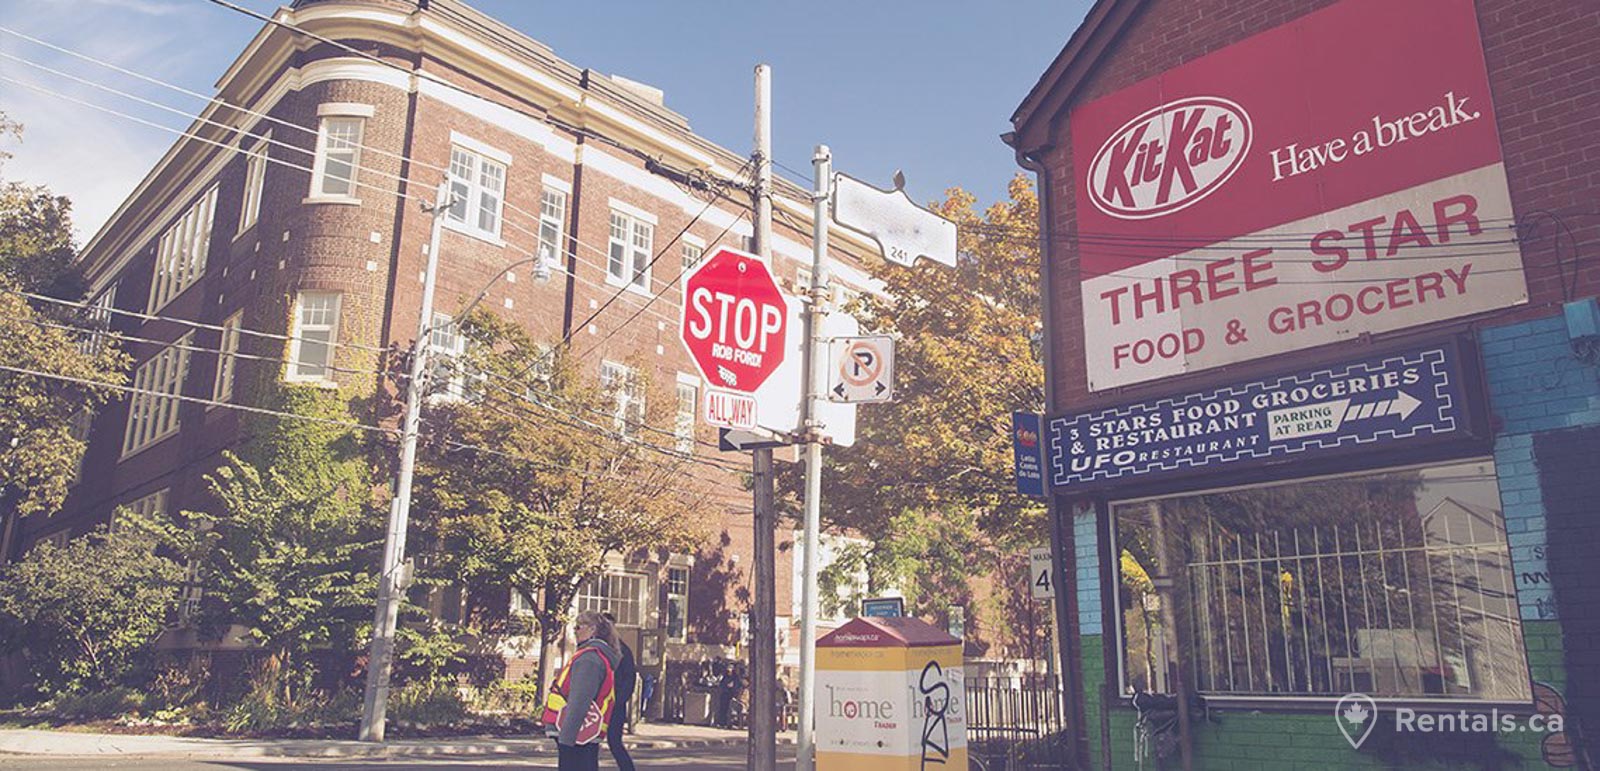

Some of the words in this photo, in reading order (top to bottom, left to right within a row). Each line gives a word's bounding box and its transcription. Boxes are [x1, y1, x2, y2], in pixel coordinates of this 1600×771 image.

[1269, 137, 1347, 182] Have
[1353, 131, 1374, 155] a
[1376, 91, 1480, 147] break.
[1100, 248, 1278, 326] THREE
[1309, 194, 1484, 272] STAR
[689, 287, 782, 352] STOP
[1113, 327, 1205, 370] FOOD
[1224, 319, 1248, 346] &
[1268, 264, 1473, 335] GROCERY
[711, 342, 734, 362] ROB
[708, 394, 727, 421] ALL
[731, 398, 754, 425] WAY
[1069, 427, 1080, 441] 3
[1089, 412, 1162, 436] STARS
[1173, 399, 1240, 424] FOOD
[1252, 367, 1421, 409] GROCERIES
[1273, 406, 1333, 426] PARKING
[1069, 441, 1086, 455] &
[1096, 412, 1257, 452] RESTAURANT
[1274, 425, 1292, 438] AT
[1296, 419, 1333, 434] REAR
[1069, 450, 1136, 473] UFO
[1138, 434, 1261, 463] RESTAURANT
[825, 684, 893, 719] home
